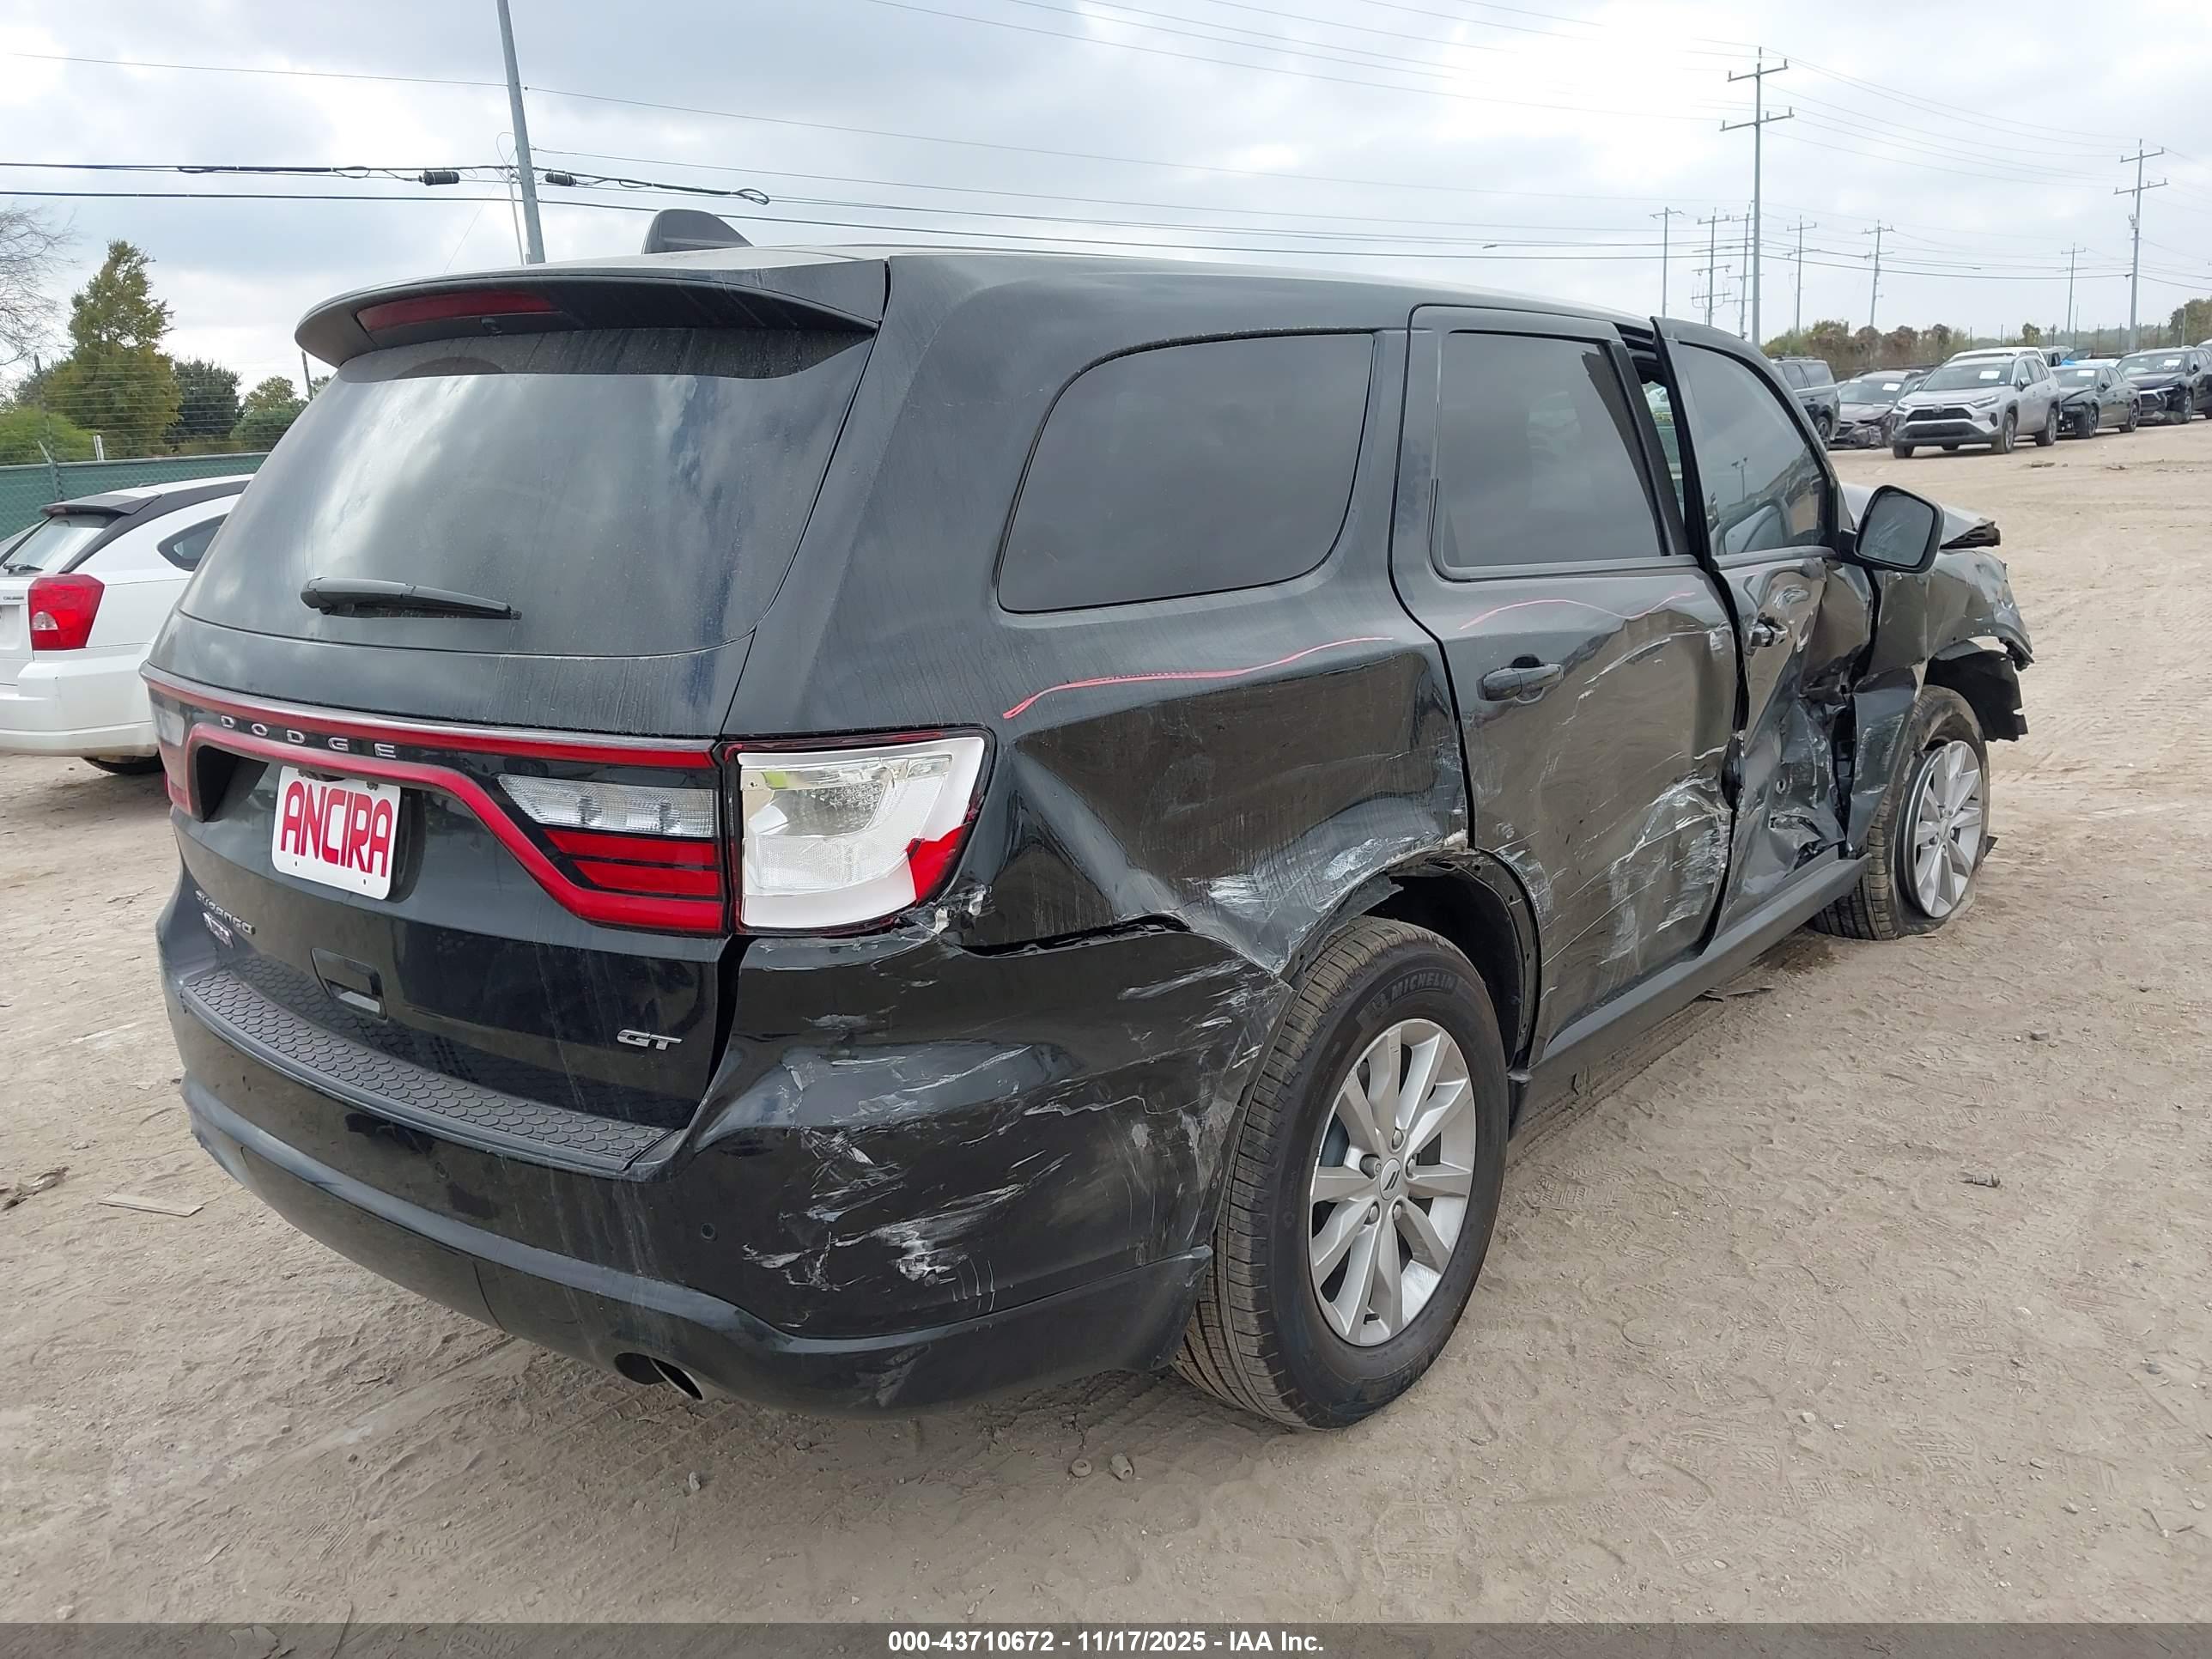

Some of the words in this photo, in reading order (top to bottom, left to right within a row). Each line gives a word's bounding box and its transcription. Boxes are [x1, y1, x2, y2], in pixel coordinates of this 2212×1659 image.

[220, 714, 397, 759] DODGE
[280, 781, 393, 878] ANCIRA
[1390, 971, 1458, 1001] MICHELIN
[617, 1029, 683, 1051] GT
